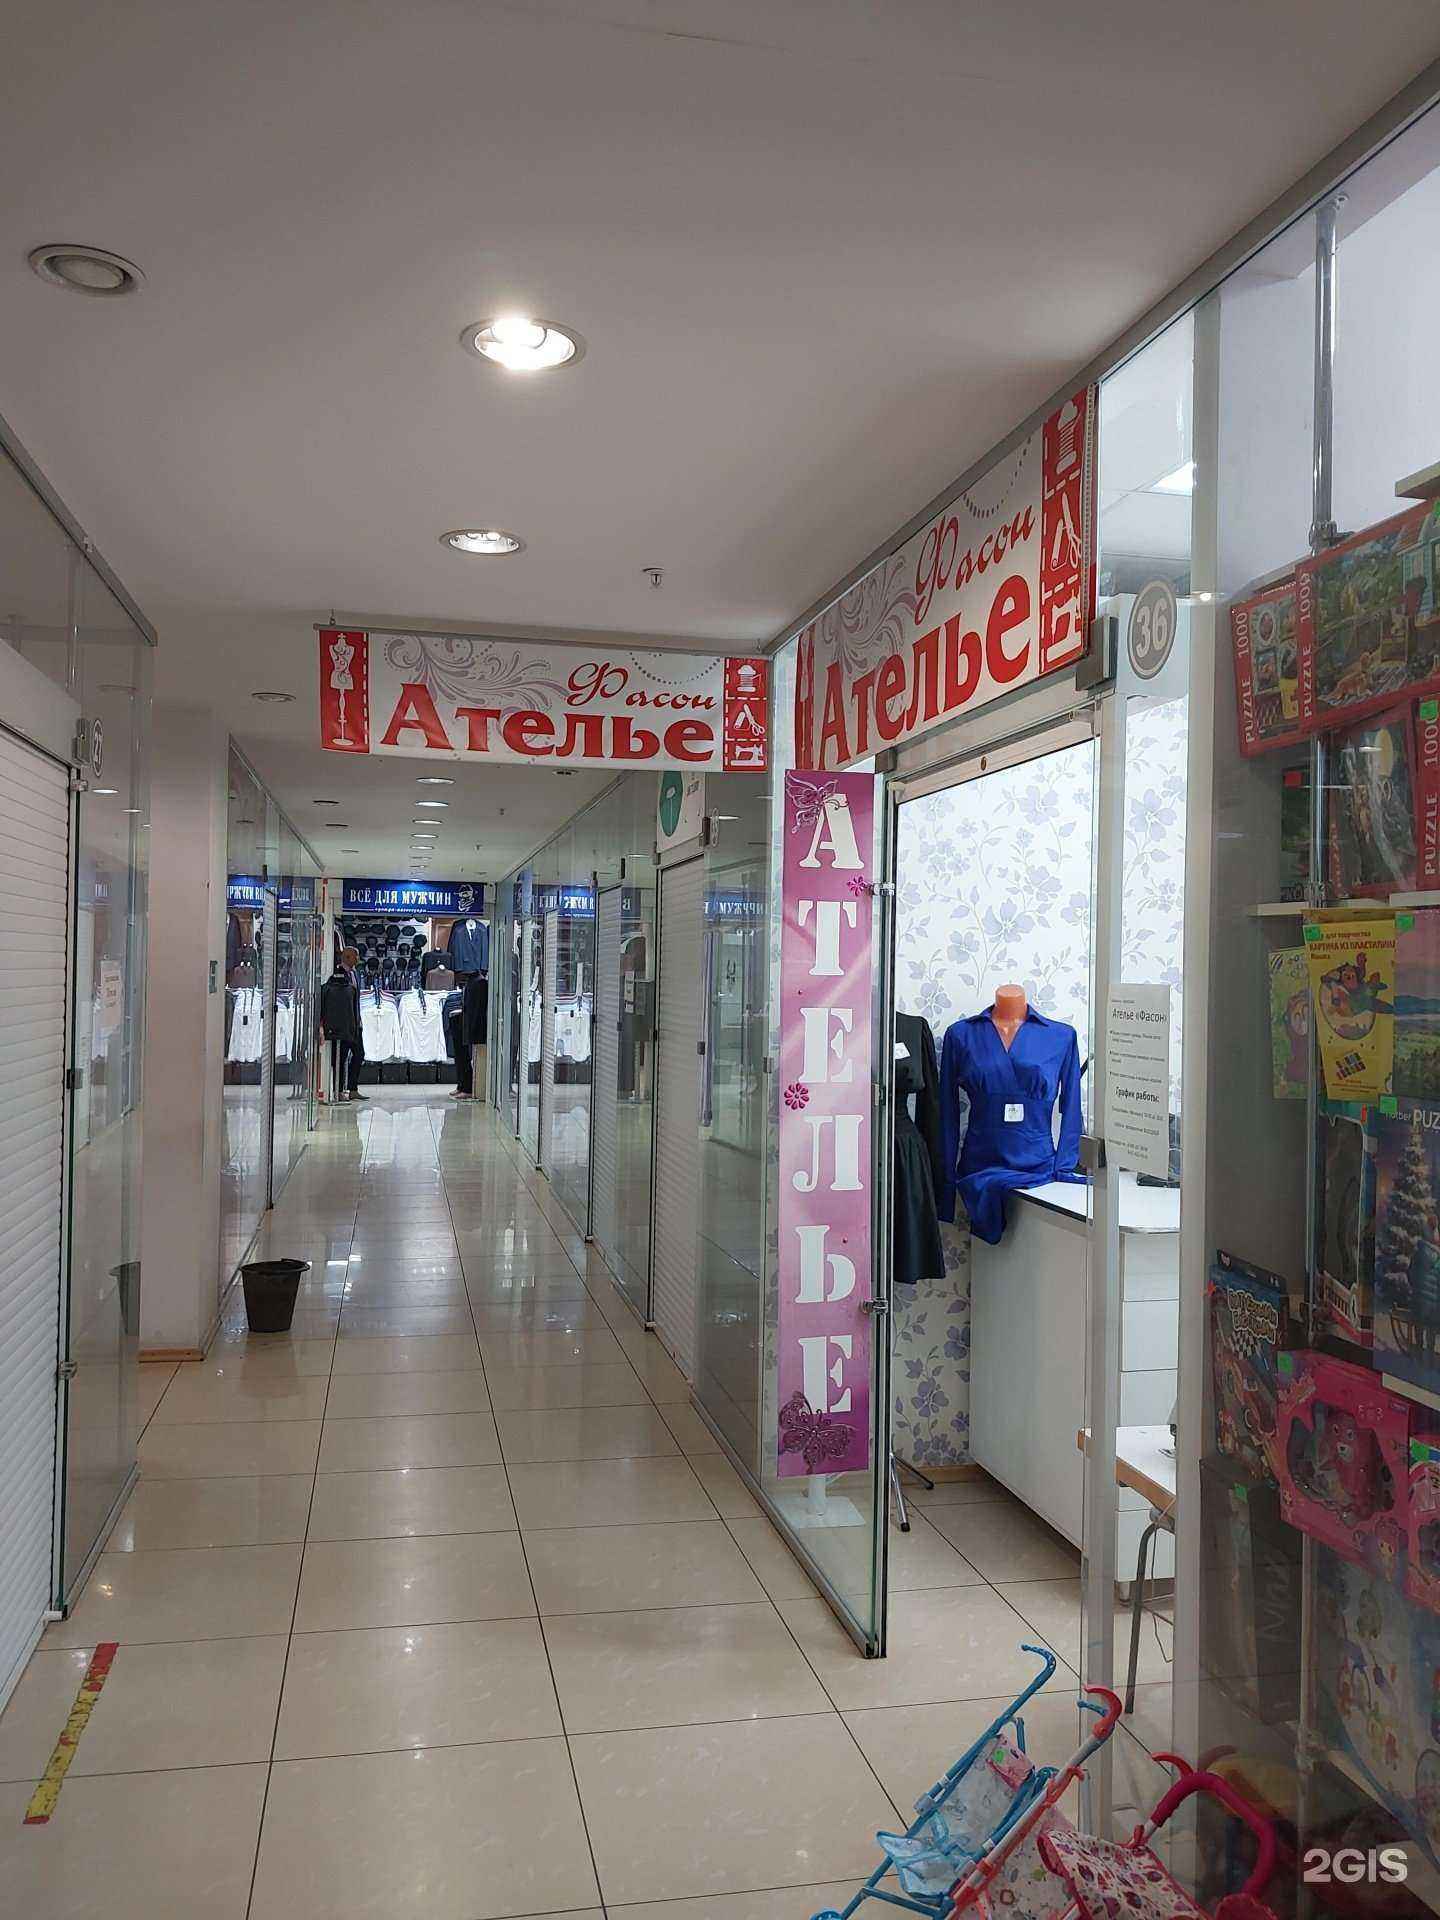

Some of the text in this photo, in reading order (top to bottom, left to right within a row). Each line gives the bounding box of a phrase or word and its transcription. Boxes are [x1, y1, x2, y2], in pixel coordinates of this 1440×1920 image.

[914, 505, 1036, 625] Фасон
[1135, 605, 1170, 658] 36
[1236, 612, 1249, 657] 1000
[567, 662, 719, 708] Фасон
[819, 574, 1031, 770] Ателье
[1302, 645, 1312, 717] PUZZLE
[380, 682, 714, 762] Ателье
[1242, 675, 1255, 743] PUZZLE
[1425, 792, 1438, 875] PUZZLE
[350, 887, 451, 906] ВСЁ ДЛЯ МУЖЧИН
[1112, 1008, 1134, 1021] Ателье
[792, 793, 864, 1415] АТЕЛЬЕ
[1115, 1086, 1135, 1099] График
